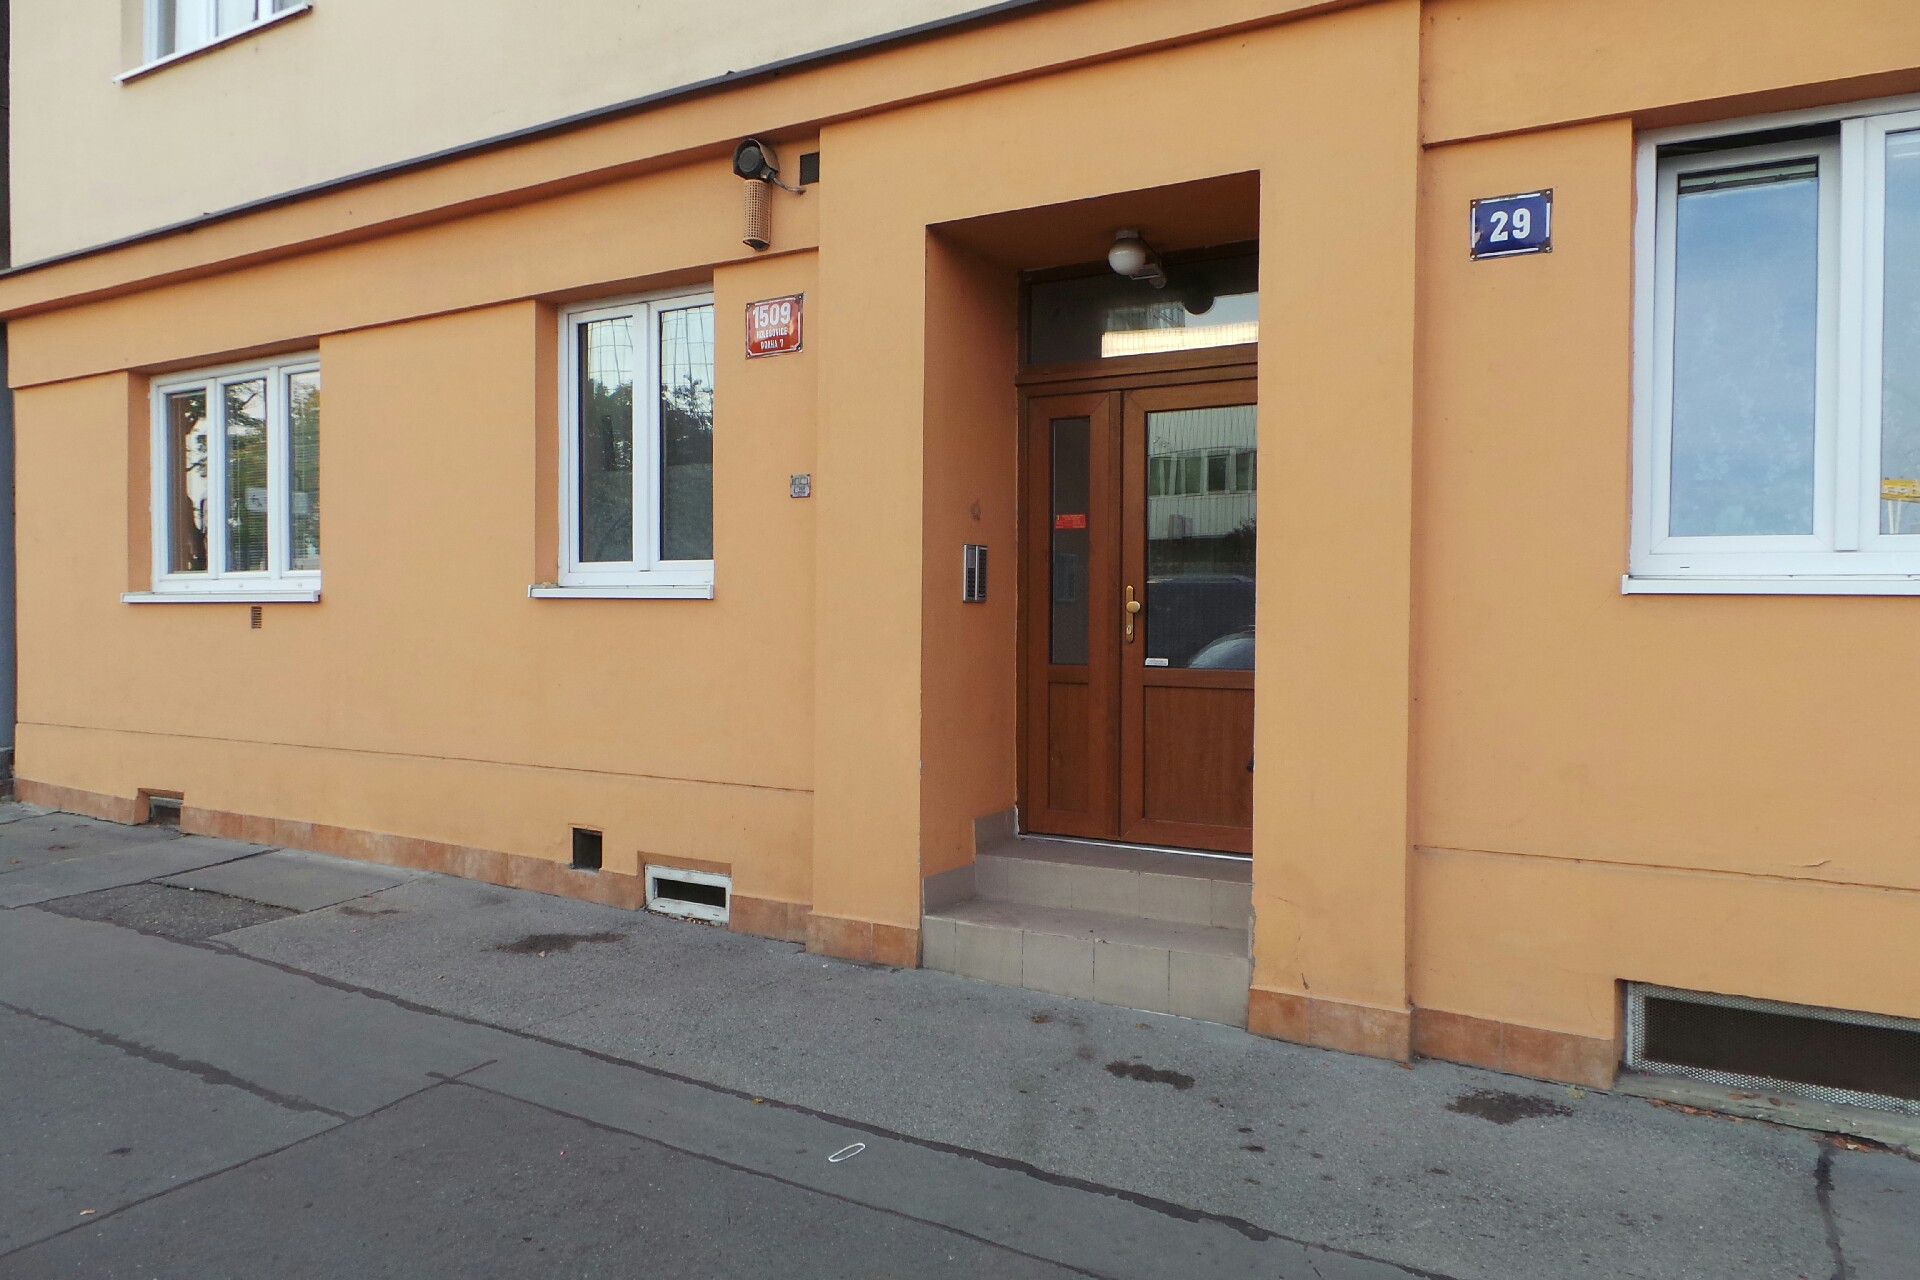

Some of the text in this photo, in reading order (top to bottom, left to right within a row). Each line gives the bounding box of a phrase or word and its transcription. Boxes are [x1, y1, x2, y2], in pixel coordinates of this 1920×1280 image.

[1490, 208, 1531, 242] 29
[753, 302, 791, 329] 1509
[760, 339, 778, 350] PRAHA
[779, 338, 784, 348] 7
